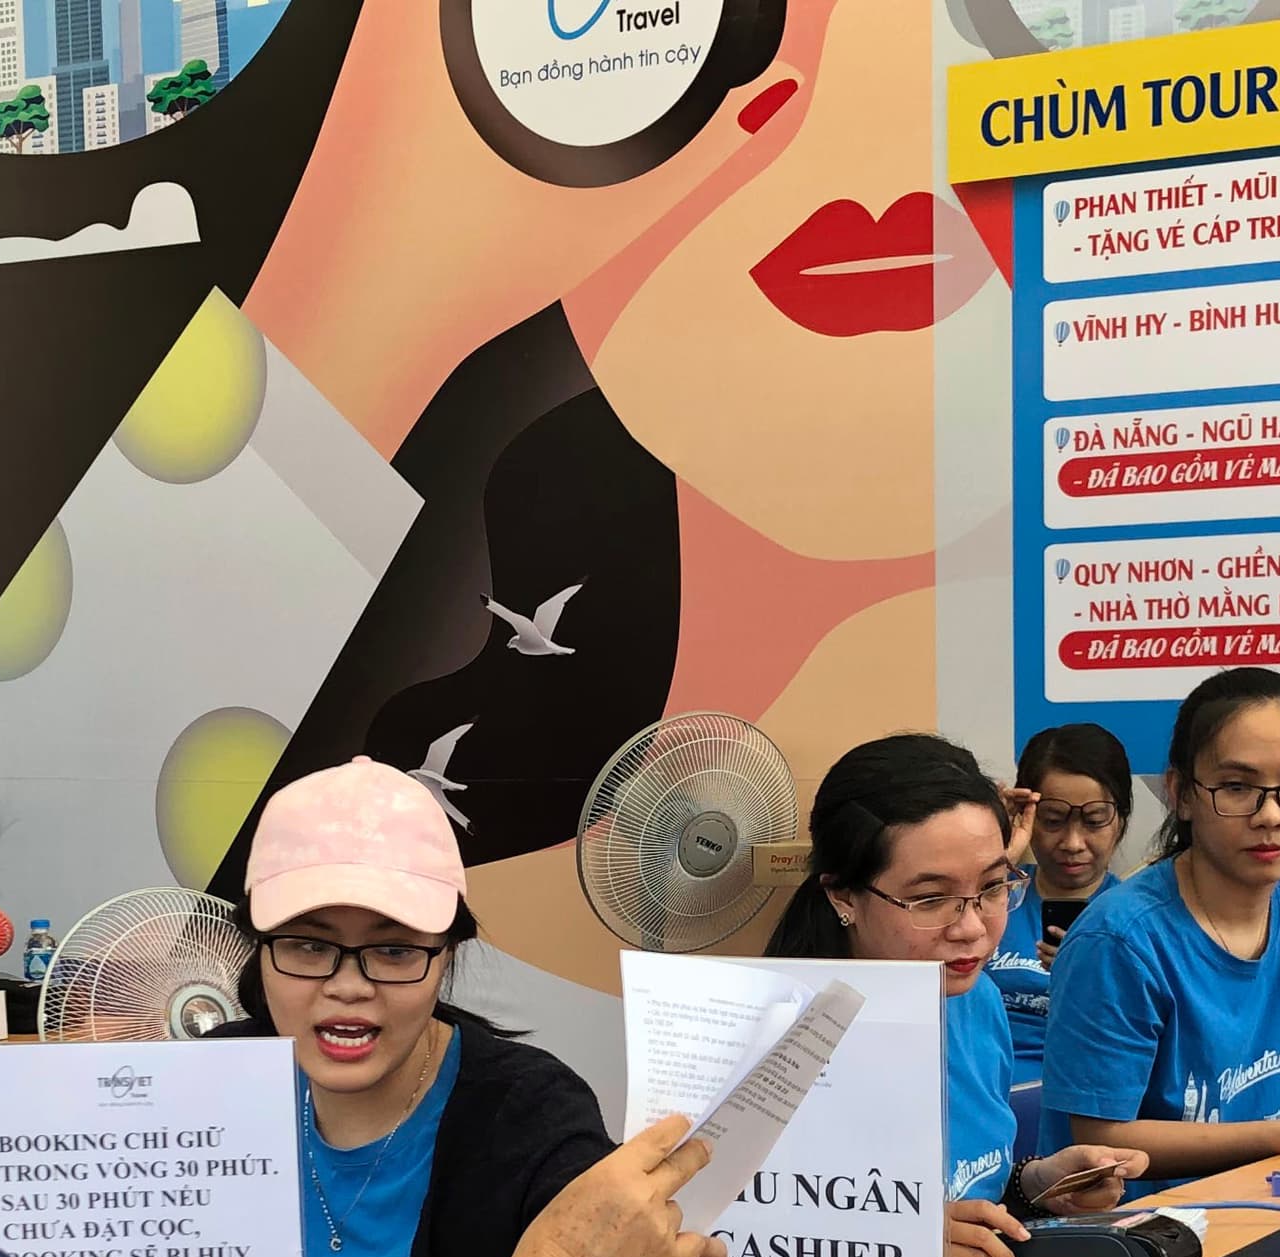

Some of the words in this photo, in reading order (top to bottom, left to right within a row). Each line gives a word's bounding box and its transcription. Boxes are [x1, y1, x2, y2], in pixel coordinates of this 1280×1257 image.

[617, 1, 679, 32] Travel
[501, 70, 532, 88] Bạn
[538, 59, 583, 81] đồng
[589, 52, 633, 74] hành
[639, 49, 659, 67] tin
[665, 44, 701, 64] cậy
[981, 79, 1126, 146] CHÙM
[1143, 66, 1278, 127] TOUR
[1075, 192, 1136, 219] PHAN
[1144, 175, 1208, 211] THIẾT
[1231, 172, 1276, 202] MŨI
[0, 1133, 116, 1152] BOOKING
[124, 1127, 168, 1149] CHỈ
[176, 1127, 225, 1148] GIỮ
[0, 1163, 88, 1182] TRONG
[96, 1157, 168, 1179] VÒNG
[175, 1161, 198, 1177] 30
[207, 1154, 278, 1176] PHÚT.
[2, 1194, 48, 1211] SAU
[56, 1193, 80, 1210] 30
[88, 1186, 154, 1209] PHÚT
[161, 1185, 210, 1207] NẾU
[792, 1168, 922, 1215] NGÂN
[4, 1220, 76, 1240] CHƯA
[84, 1219, 134, 1242] ĐẶT
[141, 1219, 200, 1240] CỌC,
